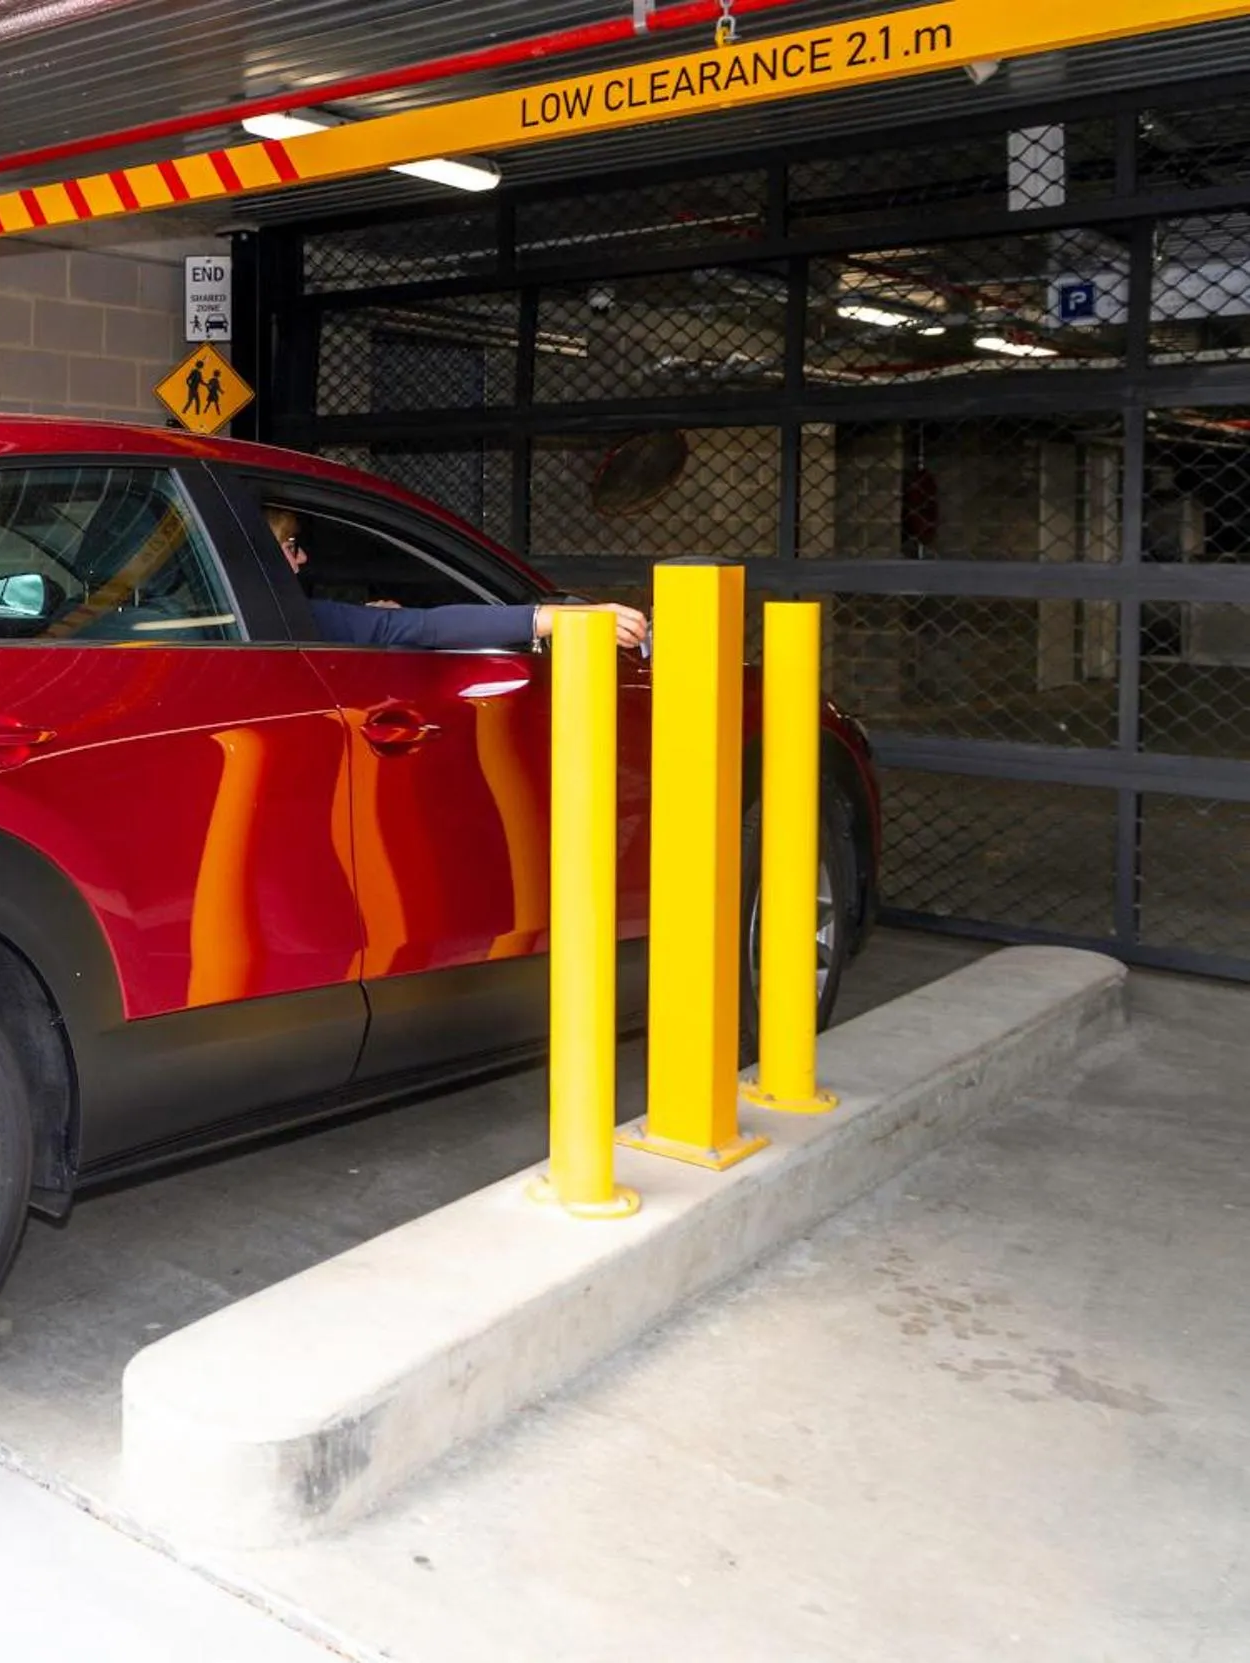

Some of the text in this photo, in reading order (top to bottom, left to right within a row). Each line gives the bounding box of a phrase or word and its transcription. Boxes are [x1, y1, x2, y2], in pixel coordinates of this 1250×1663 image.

[521, 85, 593, 128] LOW
[603, 38, 832, 112] CLEARANCE
[192, 266, 224, 282] END
[190, 294, 226, 302] SHARED
[196, 304, 220, 312] ZONE
